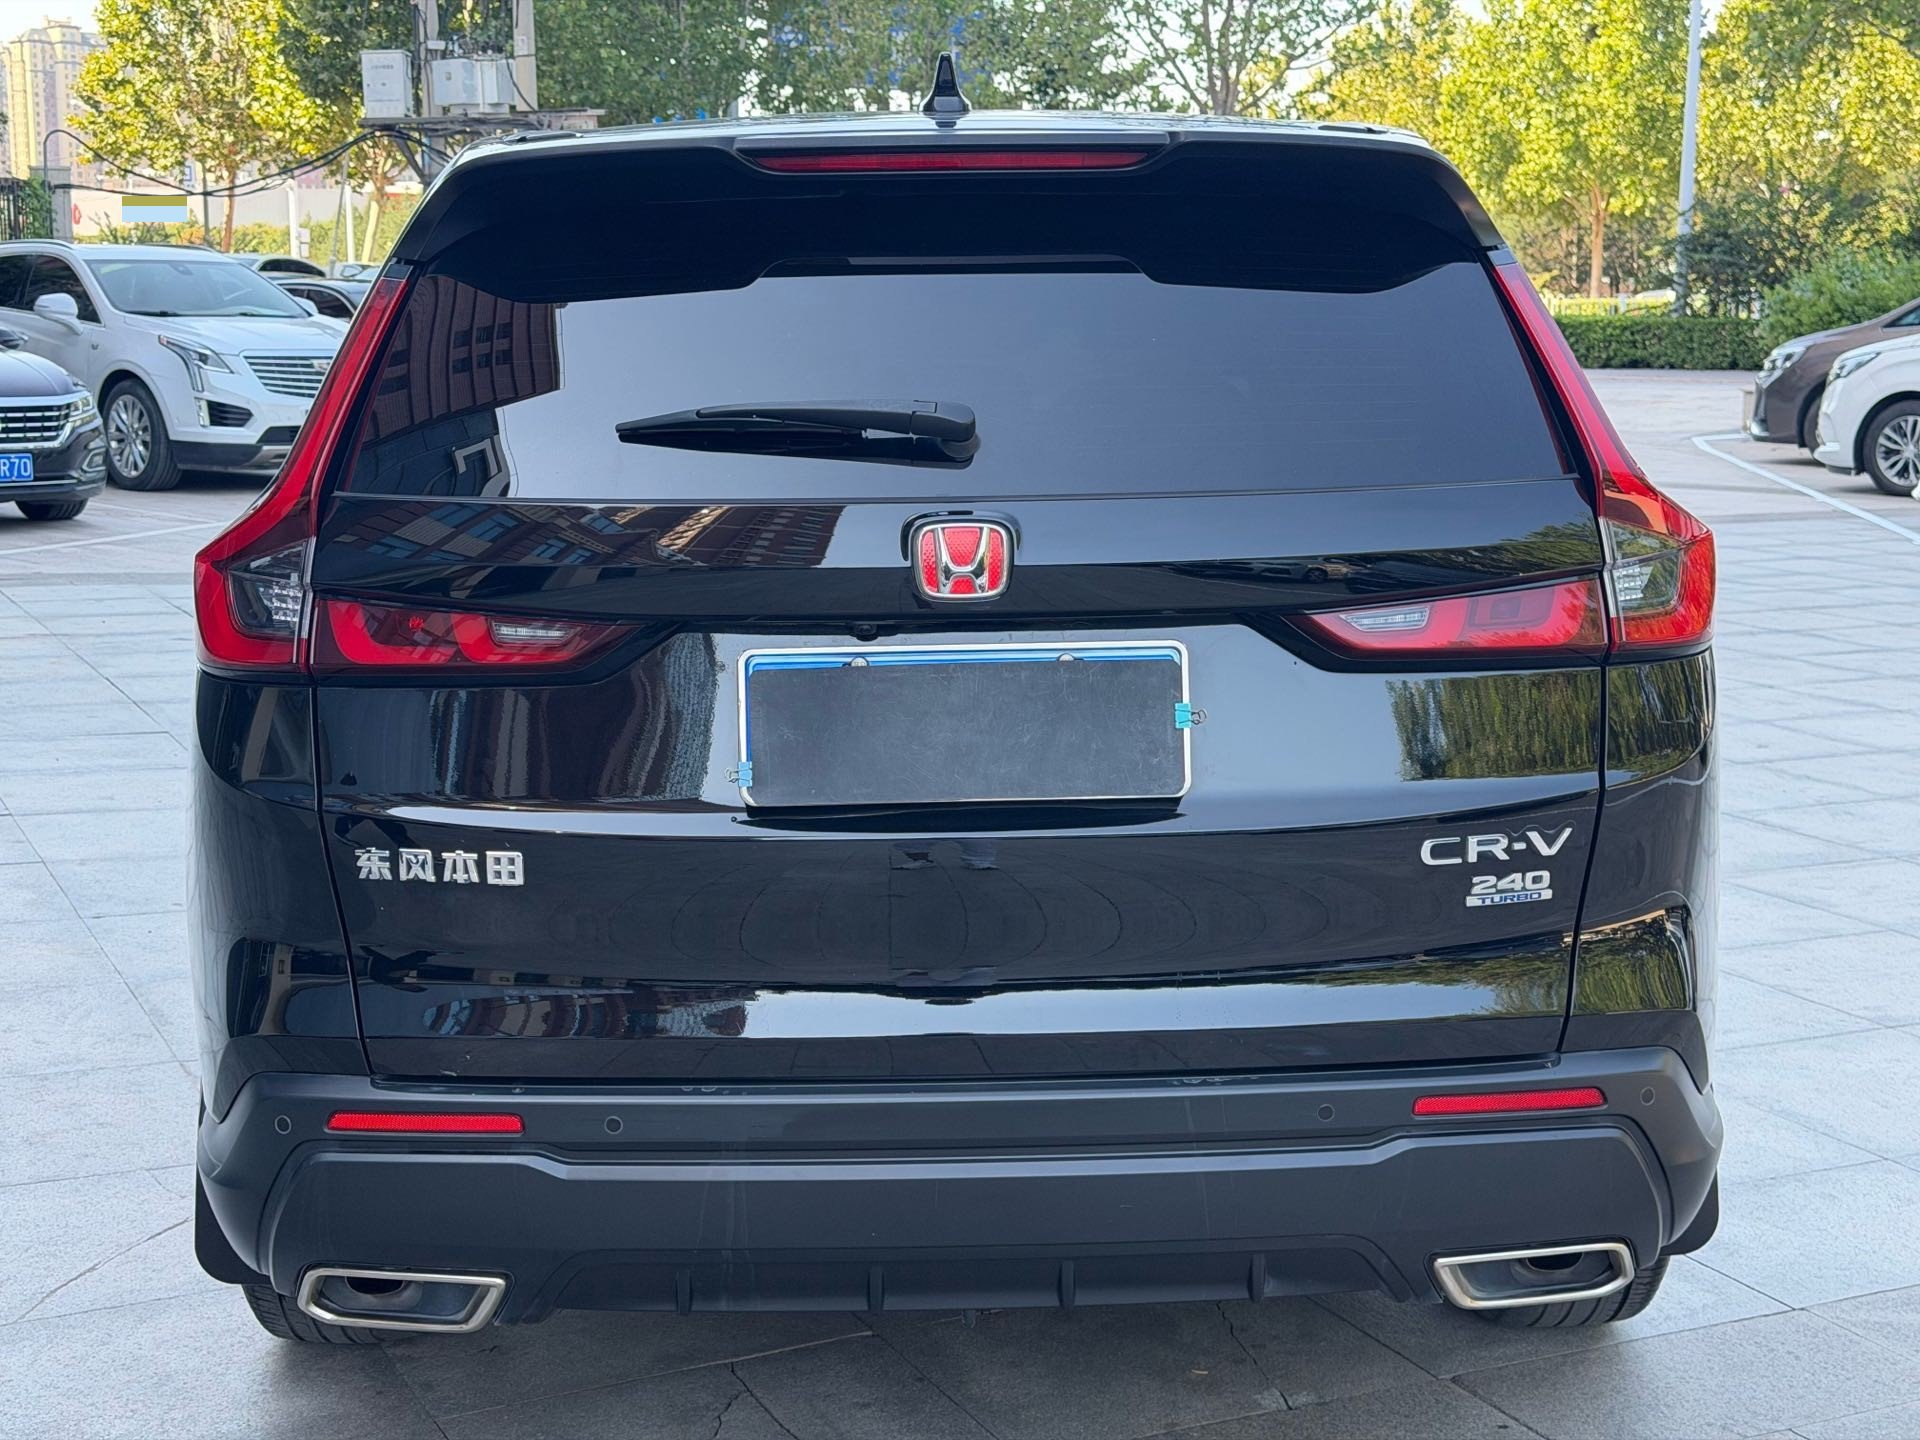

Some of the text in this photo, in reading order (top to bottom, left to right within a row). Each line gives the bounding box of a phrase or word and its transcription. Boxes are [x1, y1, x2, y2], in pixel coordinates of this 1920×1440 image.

[1420, 827, 1573, 866] CR-V
[355, 847, 525, 886] 东风本田
[1470, 870, 1550, 895] 240
[1477, 891, 1542, 905] TURBO
